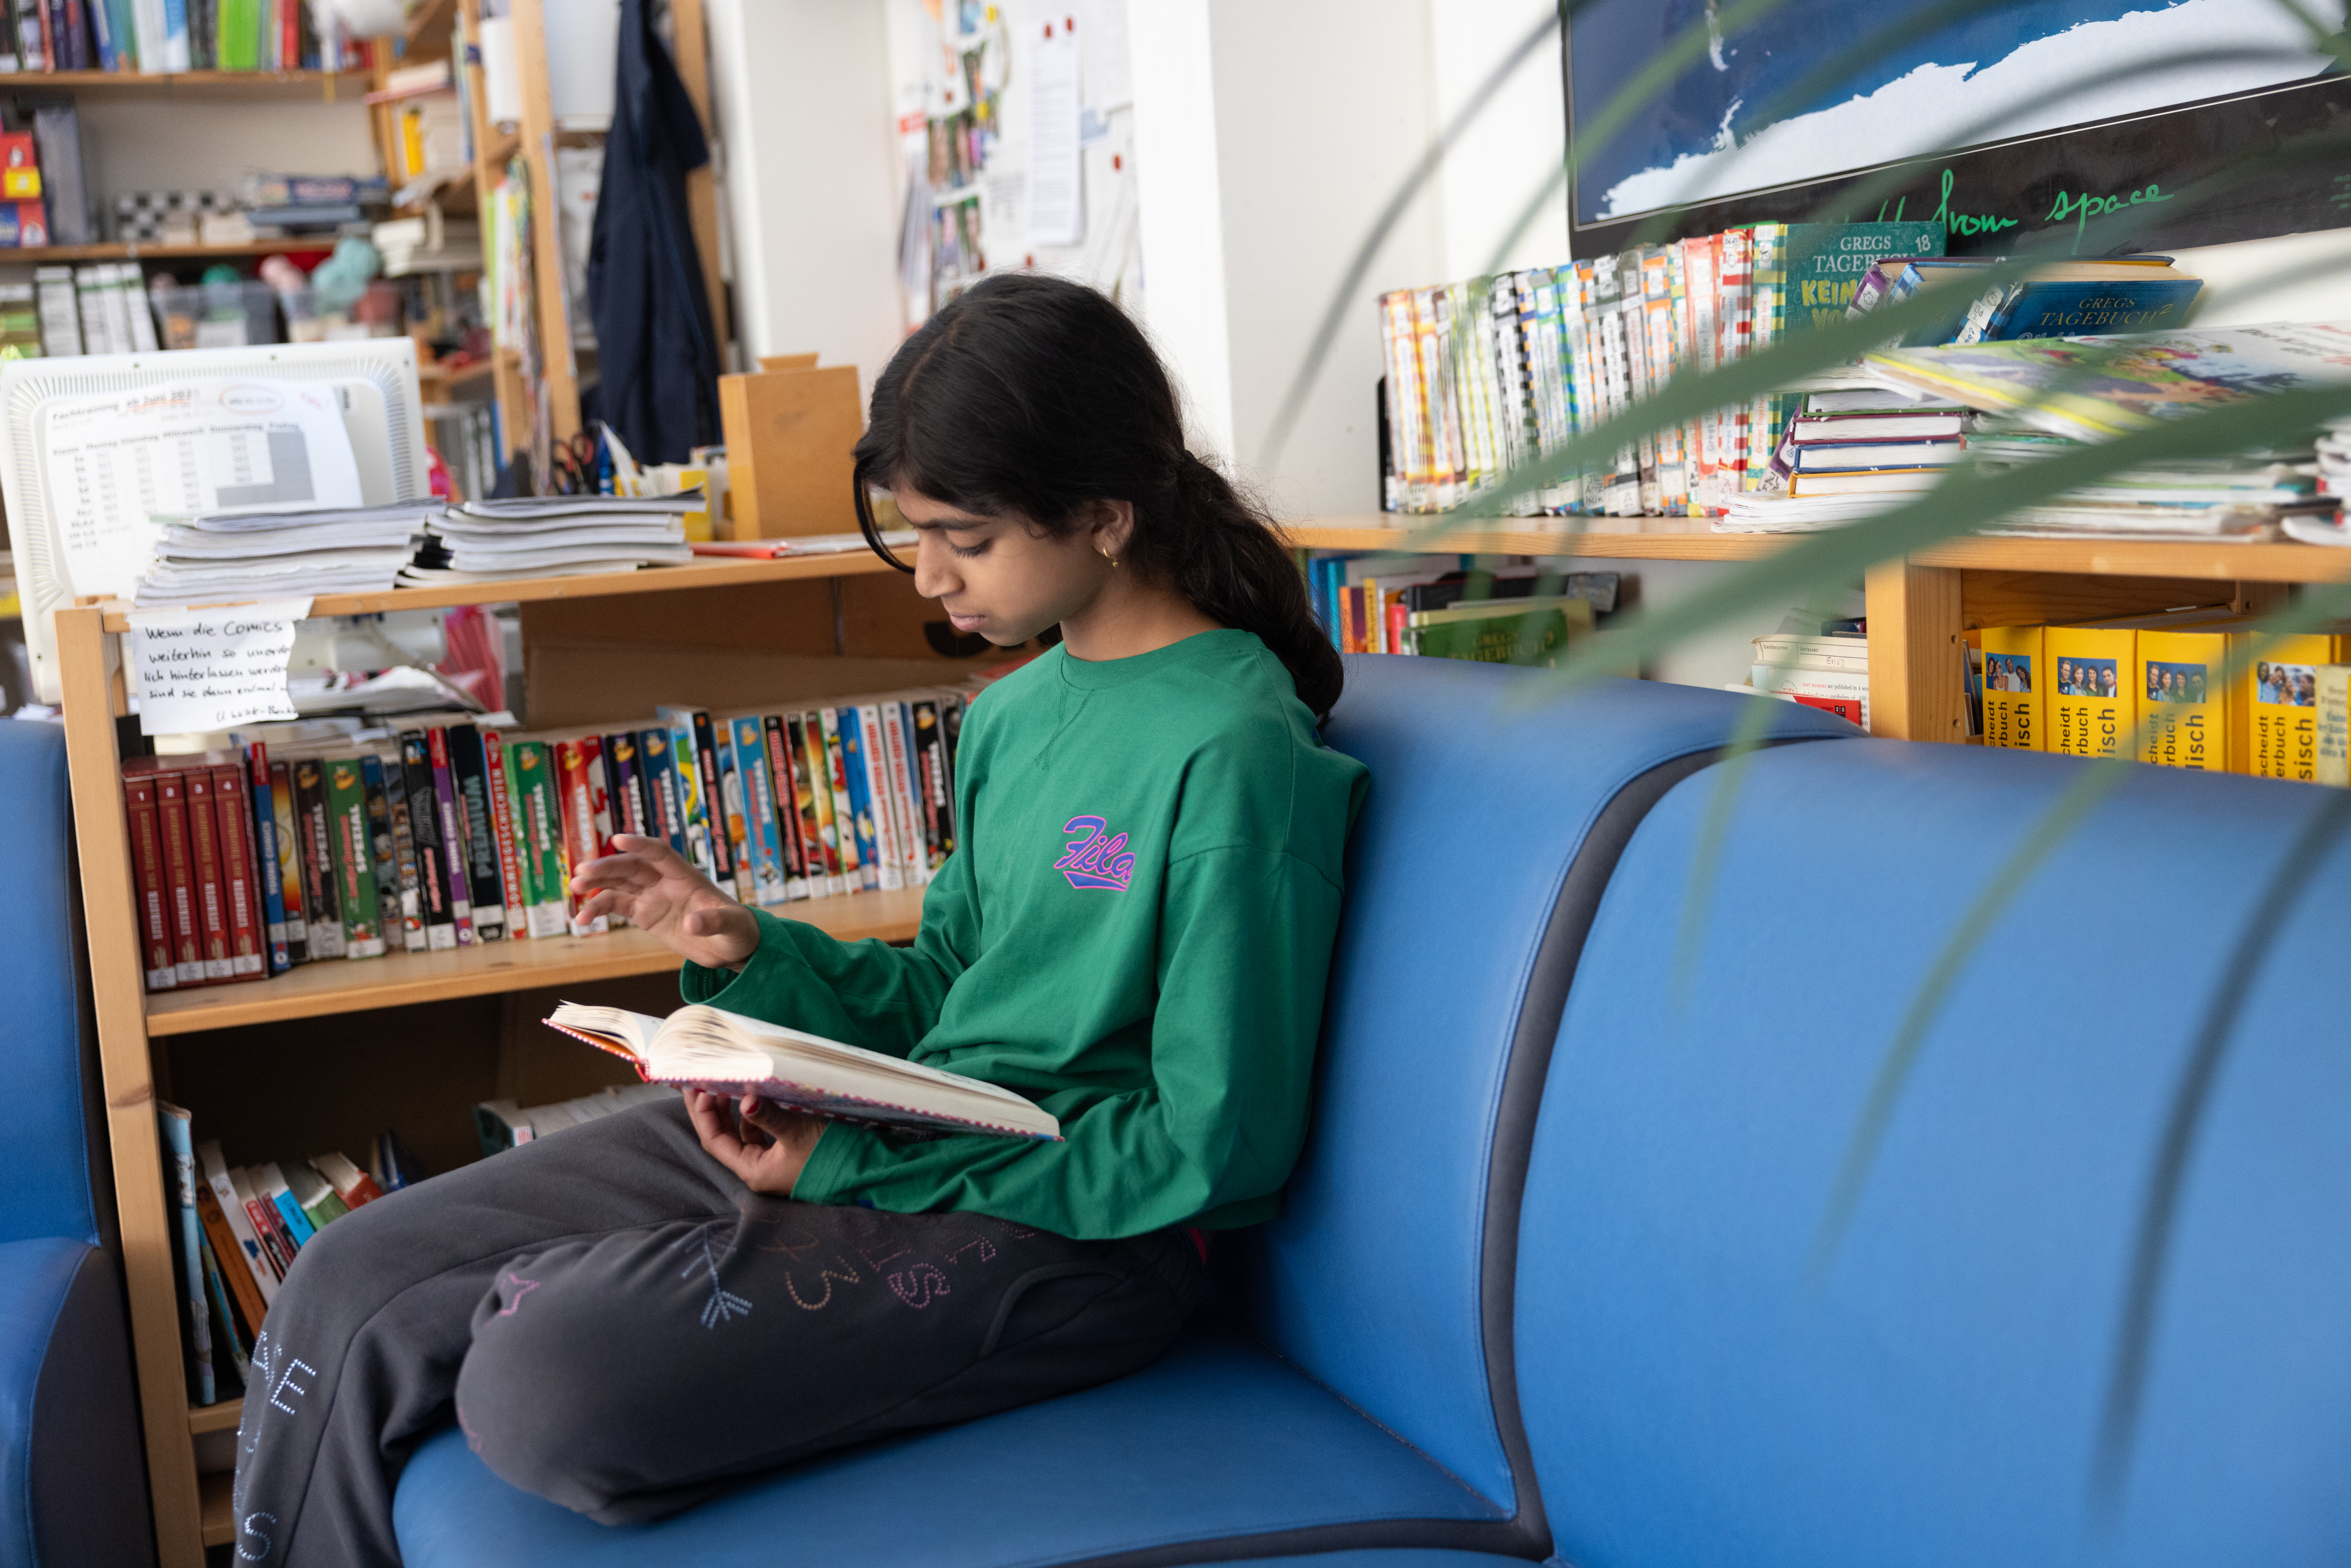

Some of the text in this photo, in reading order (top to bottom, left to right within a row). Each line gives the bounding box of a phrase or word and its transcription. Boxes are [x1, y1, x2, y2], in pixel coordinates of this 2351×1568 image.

[1931, 169, 2174, 256] from space
[1813, 254, 1917, 273] TAGEB
[1840, 237, 1891, 251] GREGS
[1915, 235, 1931, 253] 18
[2039, 311, 2157, 325] TAGEBUCH
[2079, 298, 2137, 308] GREGS
[1755, 394, 1765, 428] Tagebuc
[1755, 430, 1764, 454] Gregs
[145, 620, 283, 639] Wenn die Comics
[149, 646, 212, 663] weiterhin
[222, 648, 236, 658] so
[144, 669, 164, 682] lich
[169, 666, 243, 681] hinterlassen
[149, 687, 174, 700] sind
[183, 687, 197, 698] sie
[2076, 707, 2088, 755] rbuch
[2273, 716, 2286, 778] erbuch
[2294, 718, 2313, 780] sisch
[659, 767, 679, 835] SPEZIAL
[753, 757, 772, 824] SPEZIAL
[928, 740, 946, 808] SPEZIAL
[313, 802, 331, 873] SPEZIAL
[349, 804, 368, 874] SPEZIAL
[442, 801, 461, 875] YOUNG COMICS
[463, 774, 494, 879] PREMIUM
[532, 782, 551, 852] SPEZIAL
[576, 783, 593, 852] SPEZIAL
[262, 821, 279, 896] YOUNG COMICS
[1053, 815, 1136, 882] Fila
